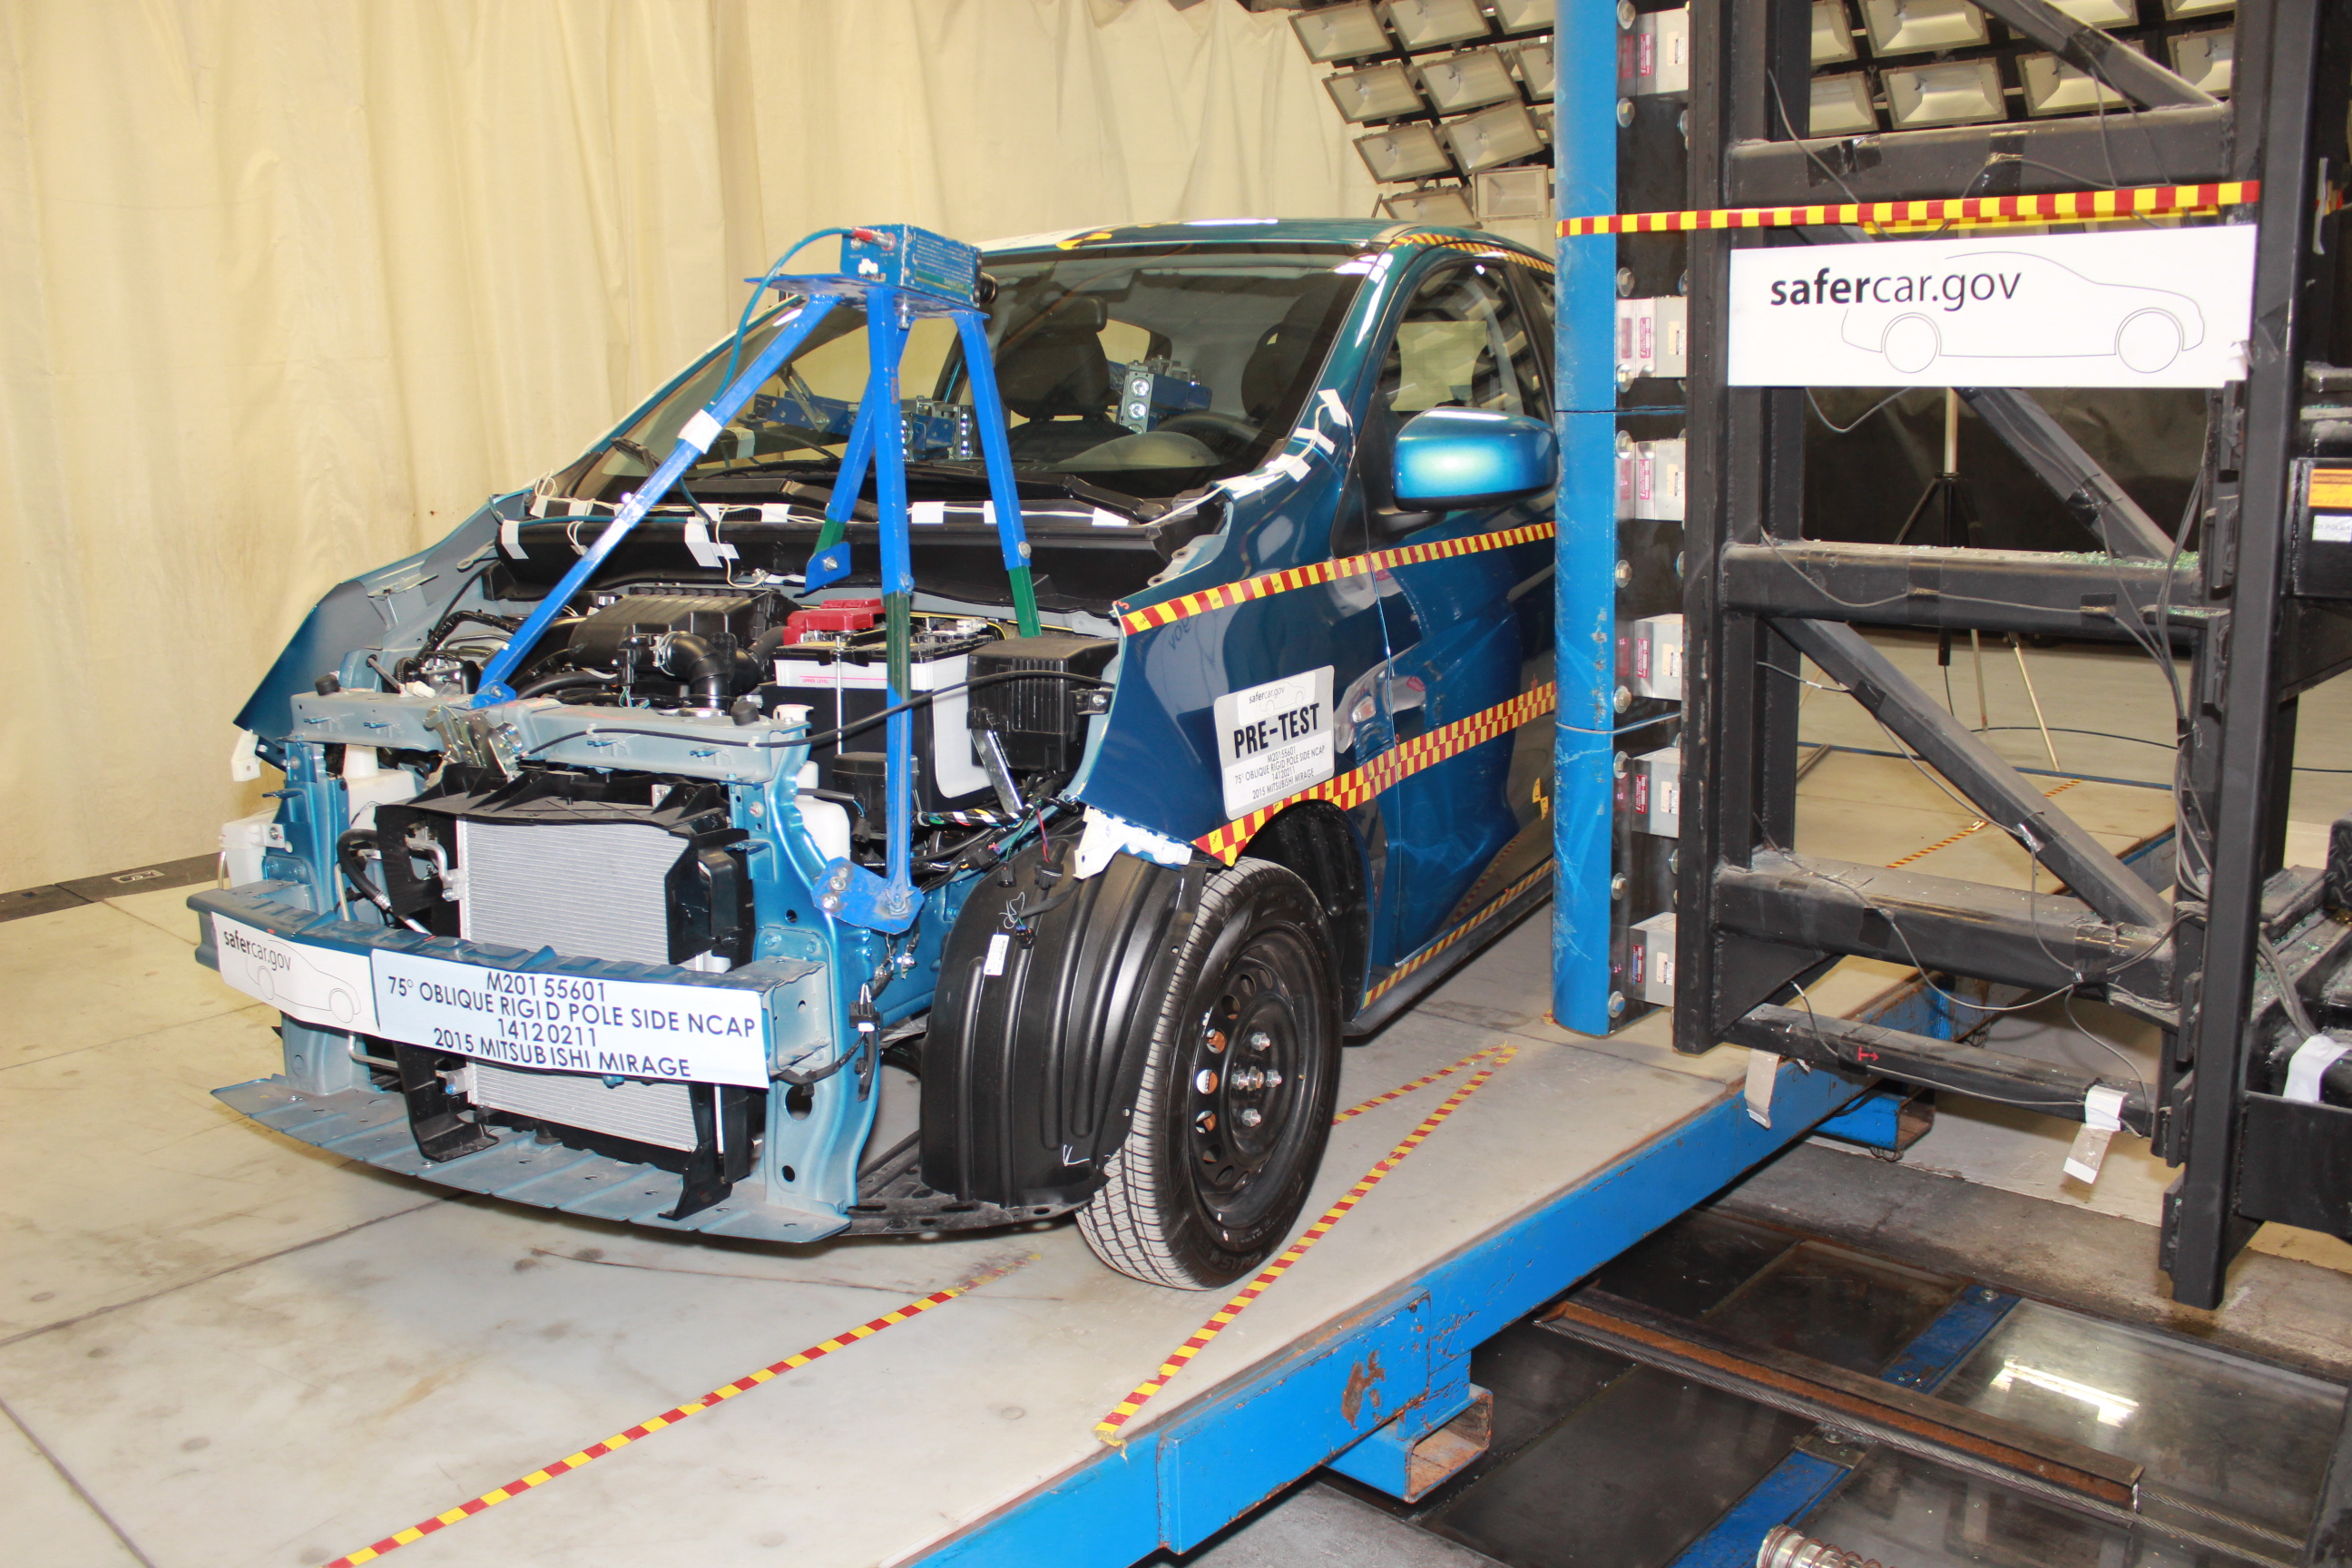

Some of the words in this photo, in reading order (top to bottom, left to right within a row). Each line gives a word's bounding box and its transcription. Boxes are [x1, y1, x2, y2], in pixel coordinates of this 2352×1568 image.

[1769, 267, 2023, 312] safercar.gov
[1249, 686, 1285, 704] safercar.gov
[1233, 702, 1320, 759] PRE-TEST
[1245, 765, 1269, 781] OBLIQUE
[1270, 760, 1285, 772] RIGID
[1287, 755, 1299, 767] POLE
[1299, 750, 1310, 762] SIDE
[1311, 745, 1325, 758] NCAP
[1267, 746, 1296, 763] M20155601
[1252, 787, 1266, 799] 2015
[1267, 777, 1294, 794] MITSUBISHI
[1295, 769, 1315, 783] MIRAGE
[1271, 766, 1296, 782] 14120211
[223, 930, 291, 971] safercar.gov
[419, 982, 495, 1014] OBLIQUE
[500, 995, 561, 1021] RIGID
[569, 1003, 623, 1026] POLE
[631, 1008, 680, 1031] SIDE
[688, 1013, 756, 1037] NCAP
[498, 1018, 596, 1047] 14120211
[434, 1027, 475, 1053] 2015
[480, 1036, 591, 1068] MITSUBISHI
[599, 1051, 691, 1077] MIRAGE
